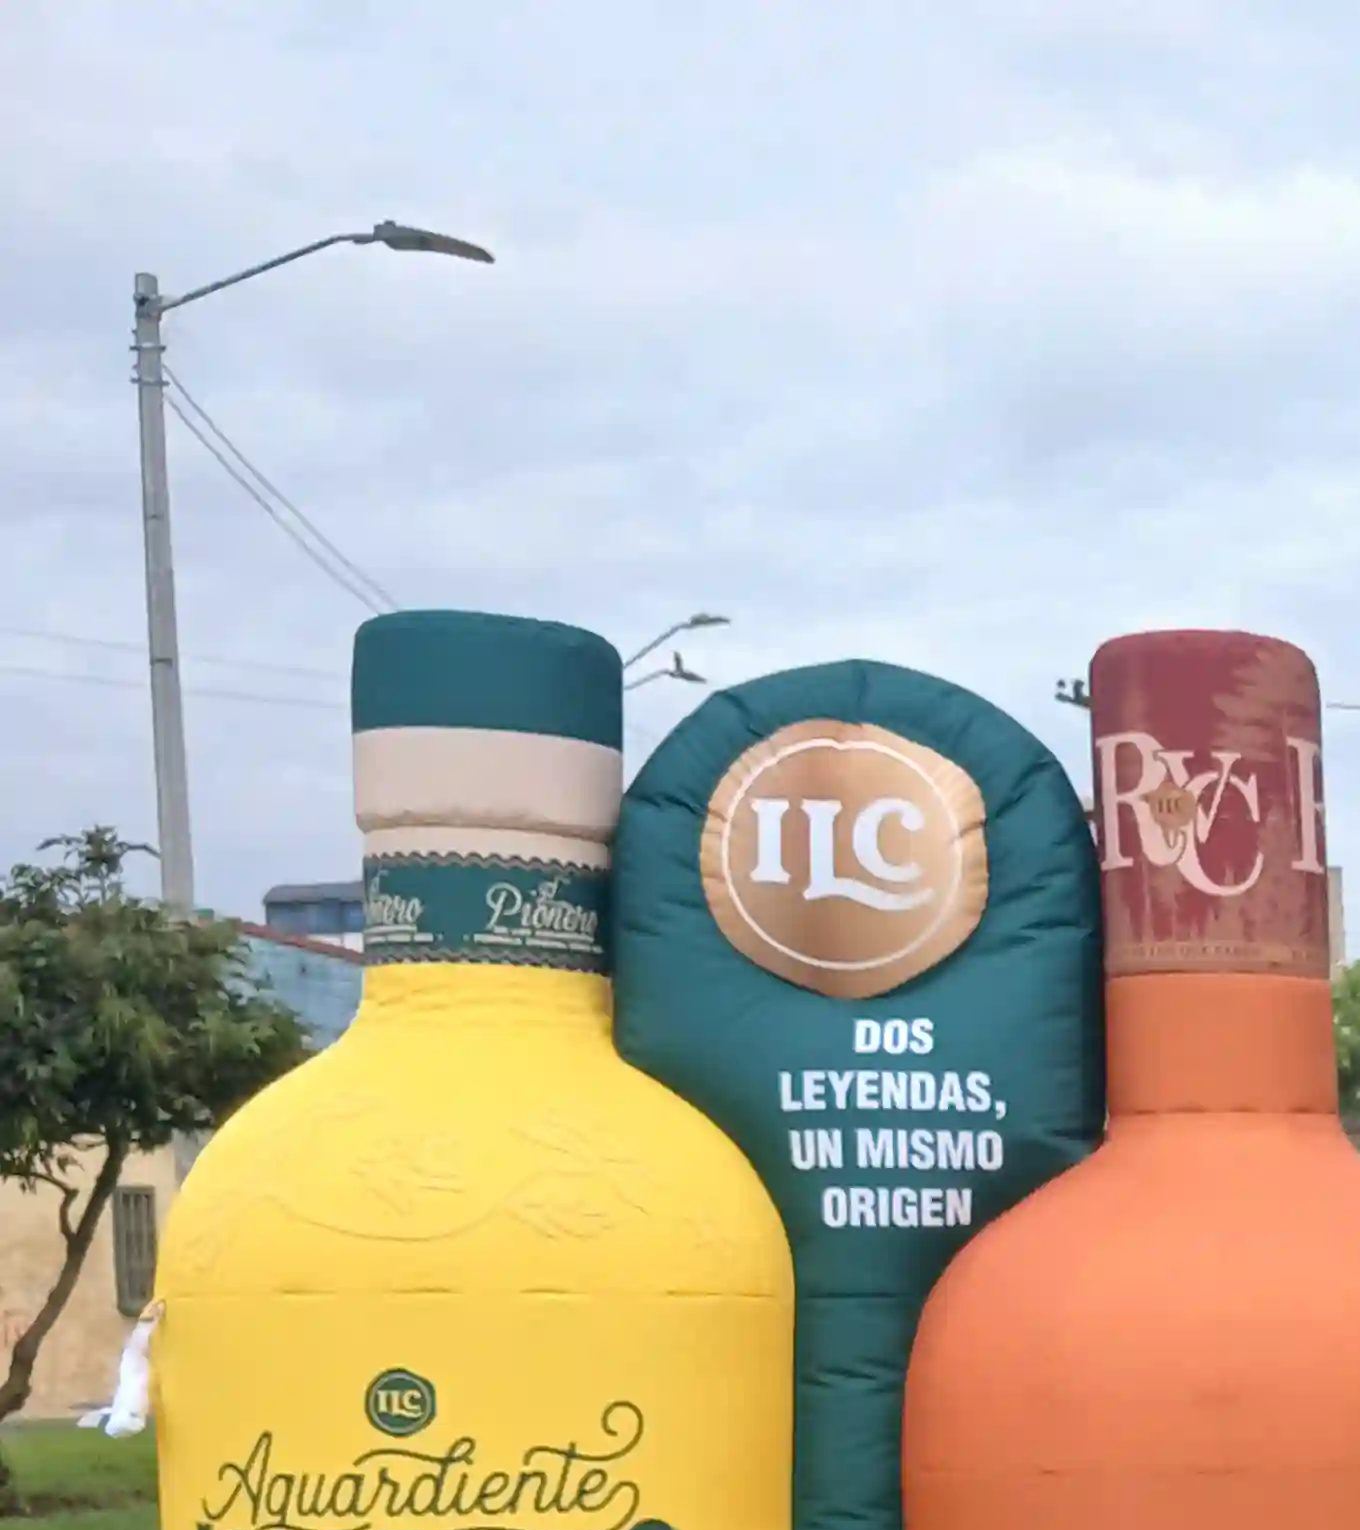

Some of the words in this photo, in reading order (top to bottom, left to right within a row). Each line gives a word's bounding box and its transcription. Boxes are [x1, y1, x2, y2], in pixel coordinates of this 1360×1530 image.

[748, 797, 934, 911] ILC
[854, 1018, 934, 1055] DOS
[778, 1070, 1007, 1120] LEYENDAS,
[788, 1130, 846, 1171] UN
[857, 1127, 1004, 1172] MISMO
[821, 1186, 972, 1229] ORIGEN
[377, 1389, 423, 1419] ILC
